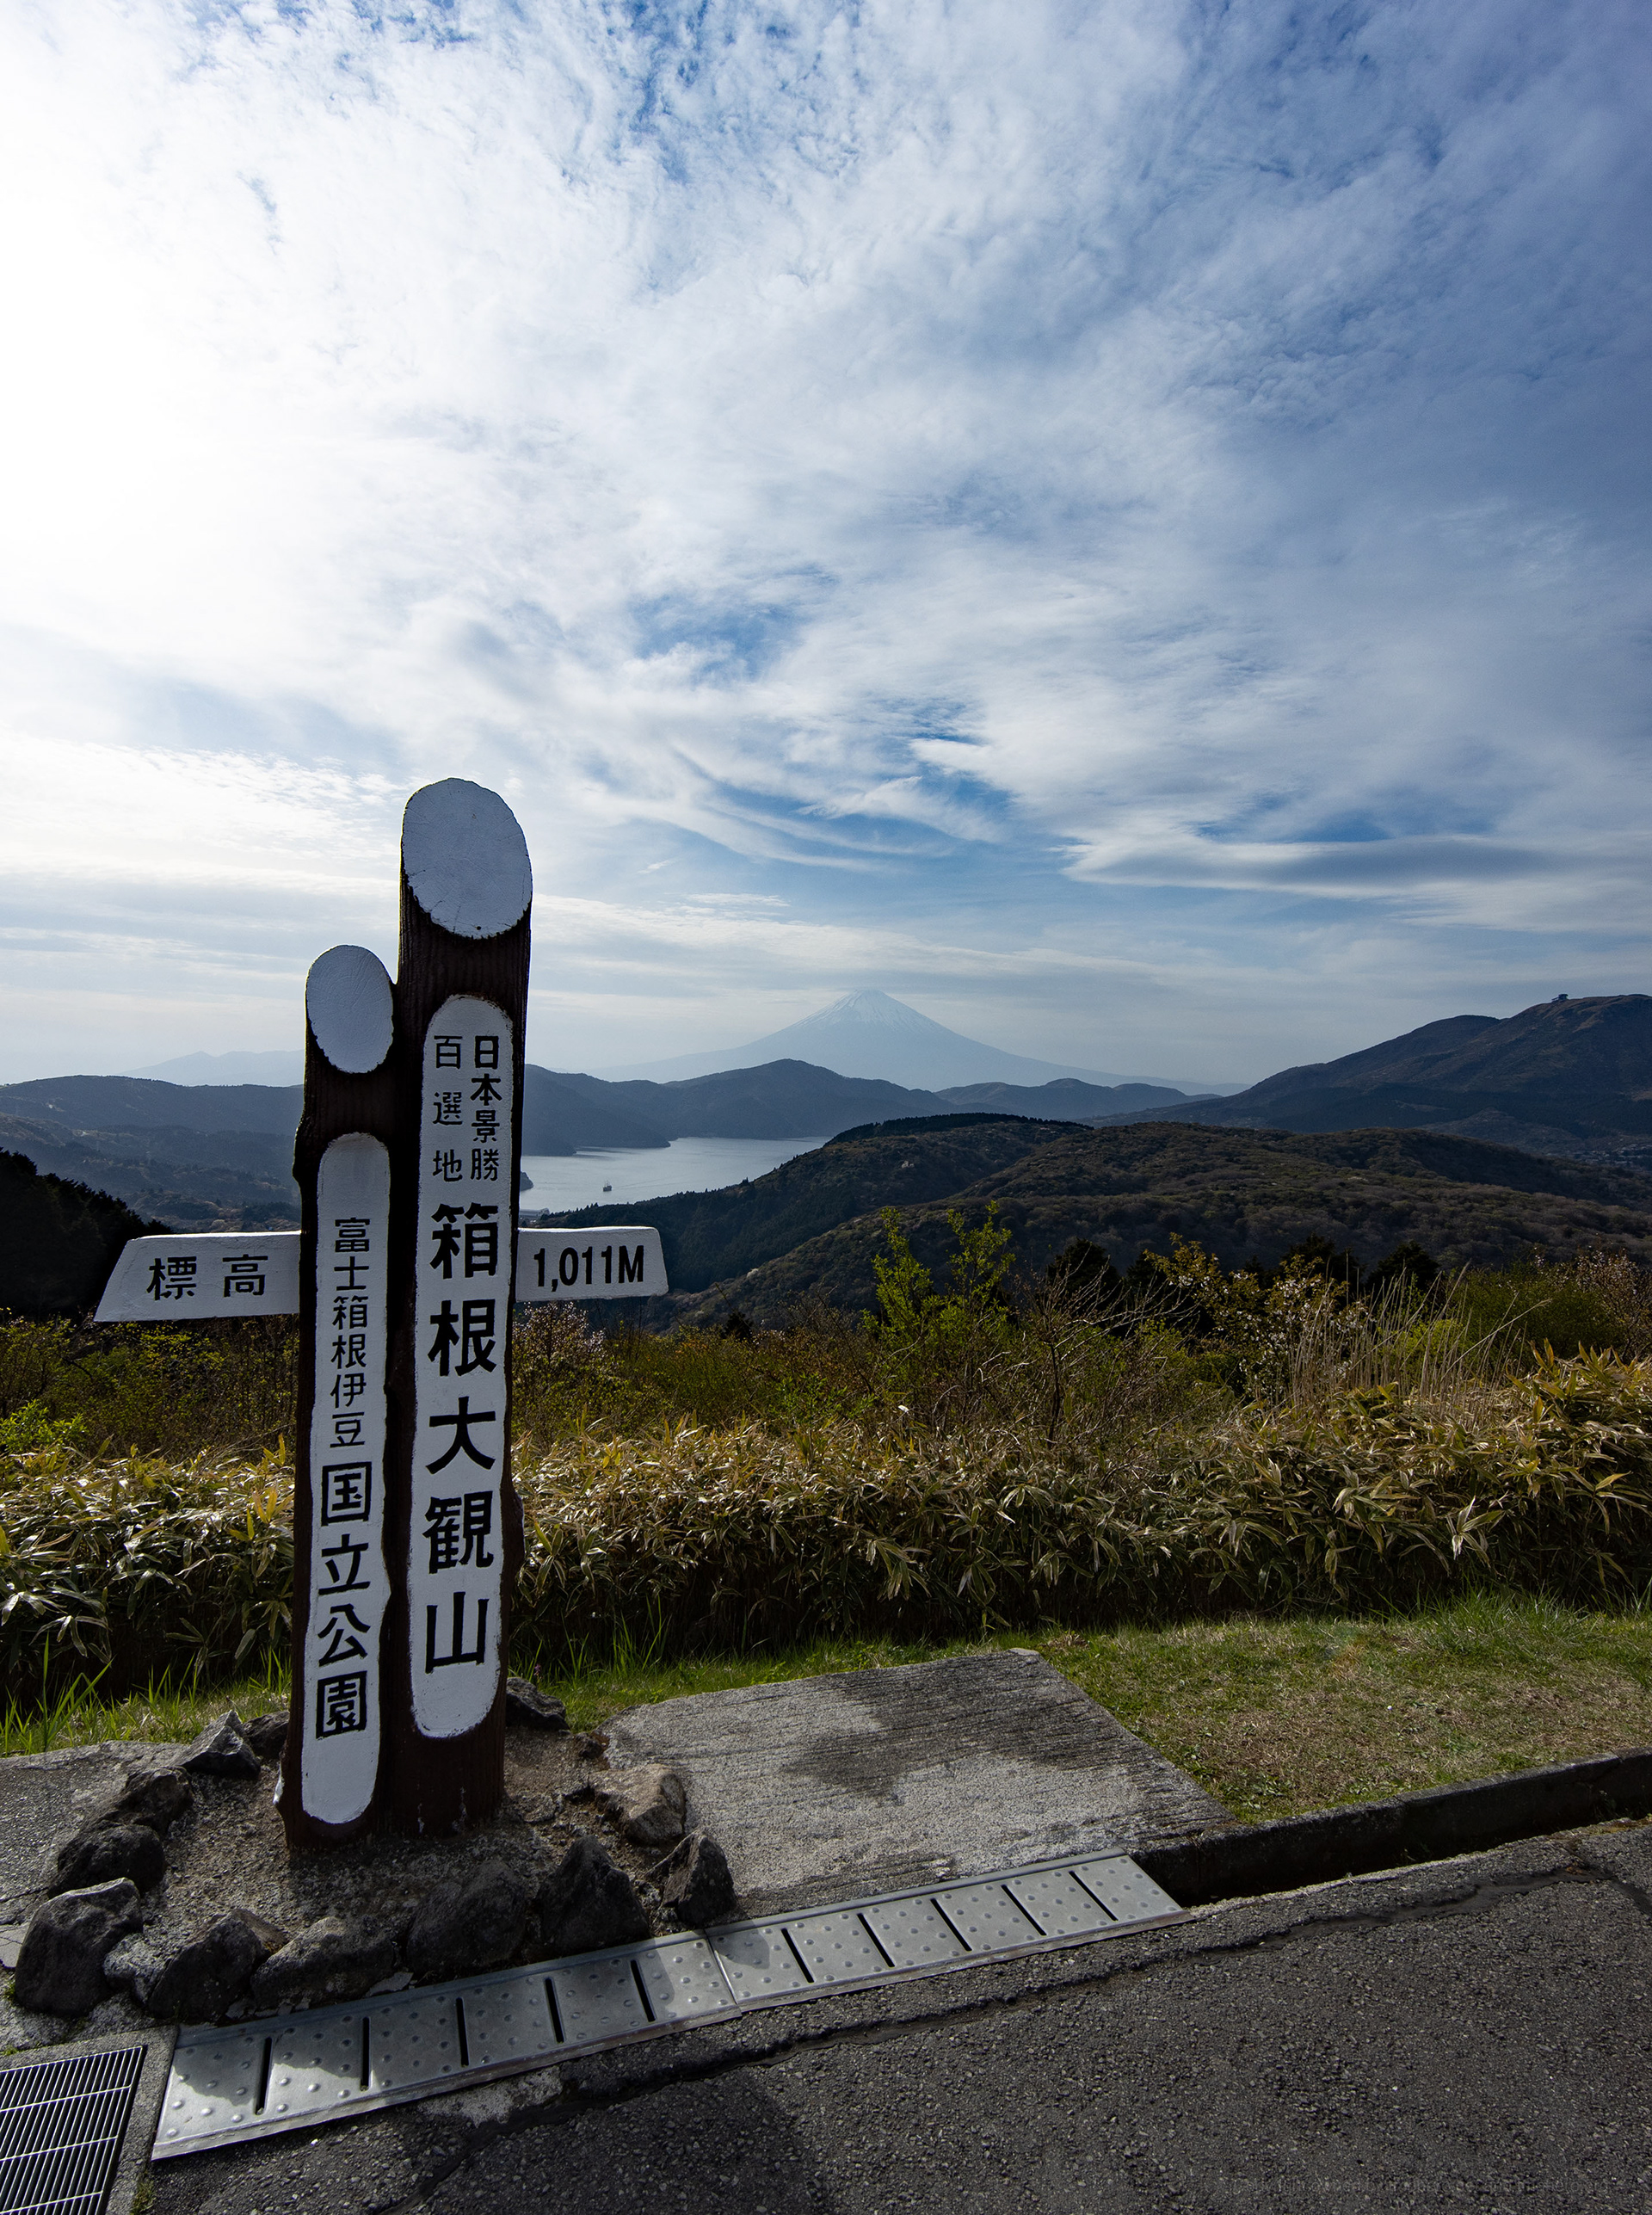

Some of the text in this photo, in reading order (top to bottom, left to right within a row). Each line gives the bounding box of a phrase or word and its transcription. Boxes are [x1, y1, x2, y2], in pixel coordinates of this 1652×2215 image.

[432, 1034, 463, 1182] 百選地
[470, 1035, 502, 1182] 日本景勝
[146, 1253, 268, 1301] 標高
[533, 1244, 645, 1293] 1,011M
[315, 1217, 373, 1740] 富士箱根伊豆国立公園
[422, 1202, 498, 1675] 箱根大観山
